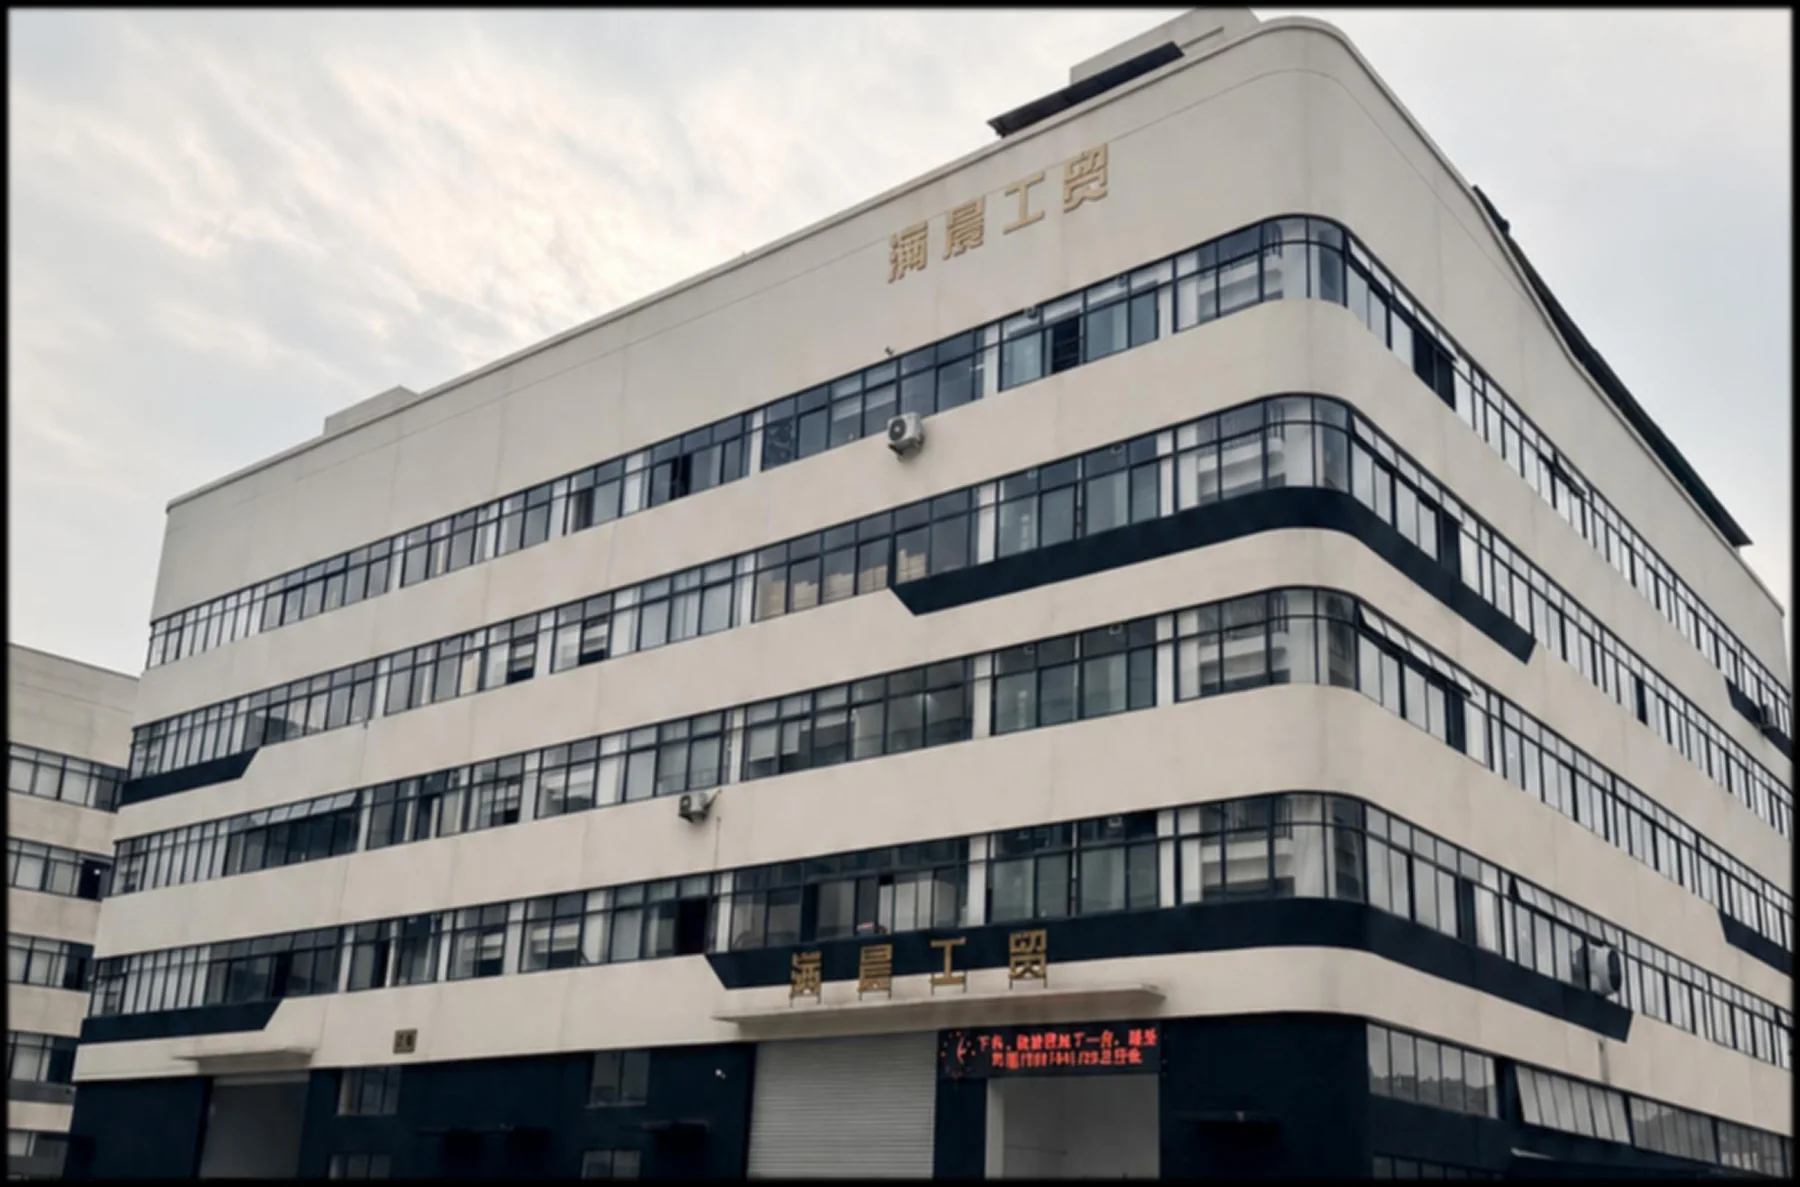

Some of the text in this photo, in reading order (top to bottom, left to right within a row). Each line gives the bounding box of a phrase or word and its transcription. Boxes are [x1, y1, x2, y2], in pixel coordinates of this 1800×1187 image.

[888, 142, 1108, 283] 满晨工贸
[790, 930, 1047, 997] 满晨工贸
